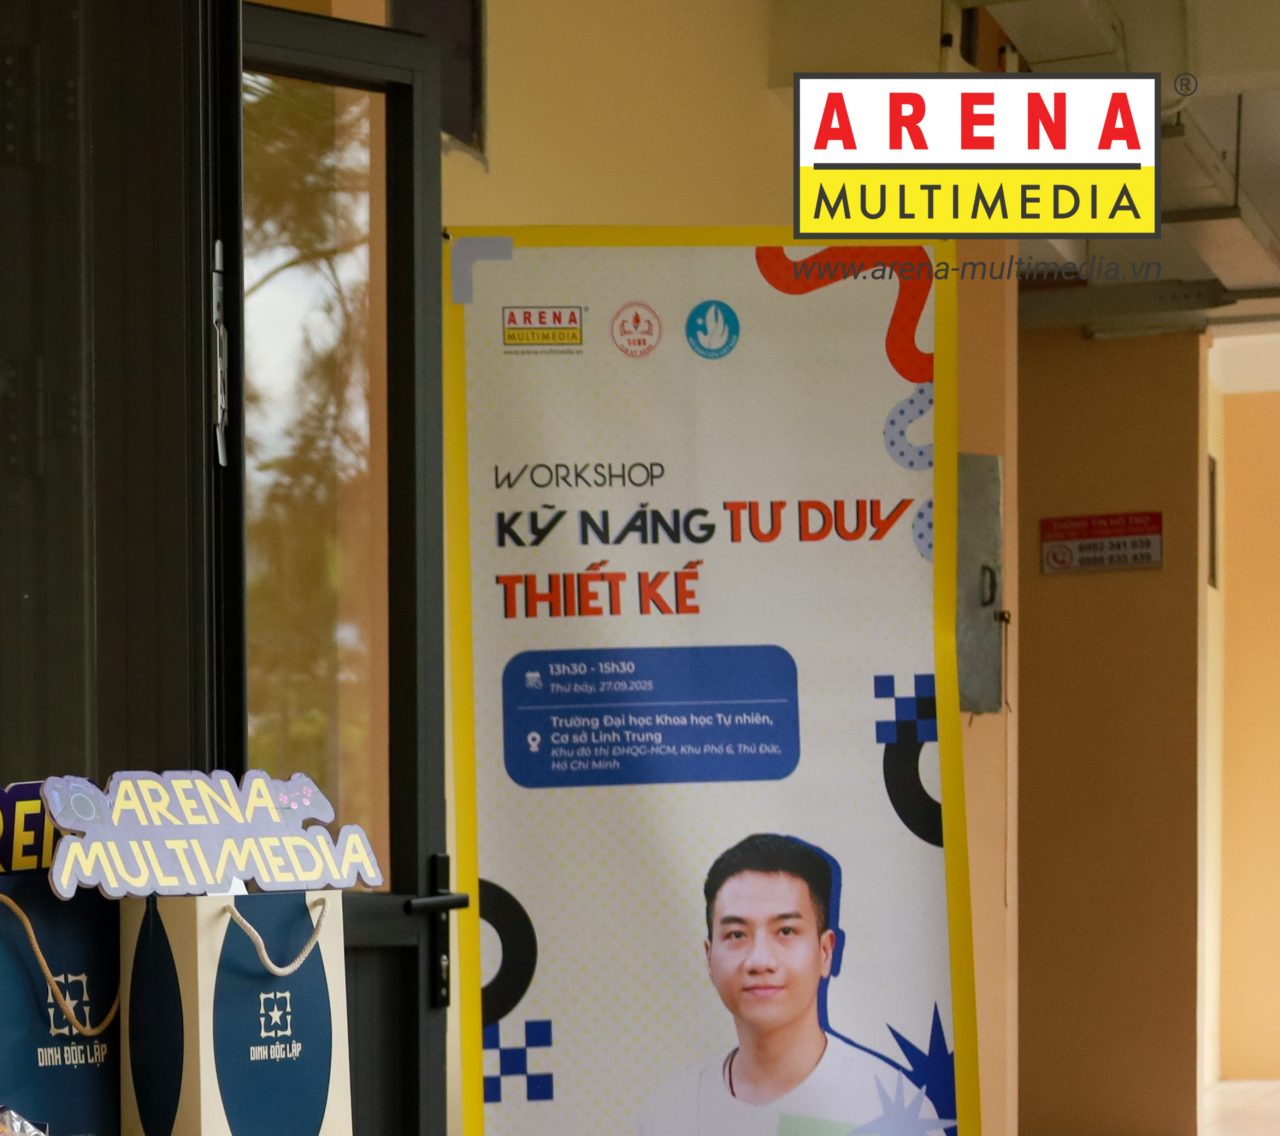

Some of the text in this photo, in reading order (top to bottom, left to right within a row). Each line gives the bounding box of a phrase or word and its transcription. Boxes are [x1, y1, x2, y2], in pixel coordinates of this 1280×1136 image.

[507, 310, 578, 326] ARENA
[507, 332, 579, 342] MULTIMEDIA
[494, 462, 665, 489] WORKSHOP
[495, 498, 914, 547] KỸ NĂNG TƯ DUY
[495, 558, 705, 619] THIẾT KẾ
[548, 662, 587, 675] 13h30
[599, 661, 635, 674] 15h30
[551, 714, 600, 729] Trường
[603, 714, 626, 727] Đại
[628, 713, 653, 727] học
[655, 713, 687, 726] Khoa
[690, 712, 713, 727] học
[716, 713, 733, 728] Tự
[551, 731, 569, 744] Cơ
[591, 730, 621, 742] Linh
[623, 731, 662, 745] Trung
[550, 746, 574, 758] Khu
[680, 744, 702, 756] Khu
[592, 758, 620, 770] Minh
[111, 777, 281, 827] ARENA
[59, 832, 377, 888] MULTIMEDIA
[37, 1046, 62, 1067] DINH
[87, 1040, 108, 1068] LẬP
[249, 1045, 268, 1061] DINH
[287, 1041, 302, 1062] LẬP
